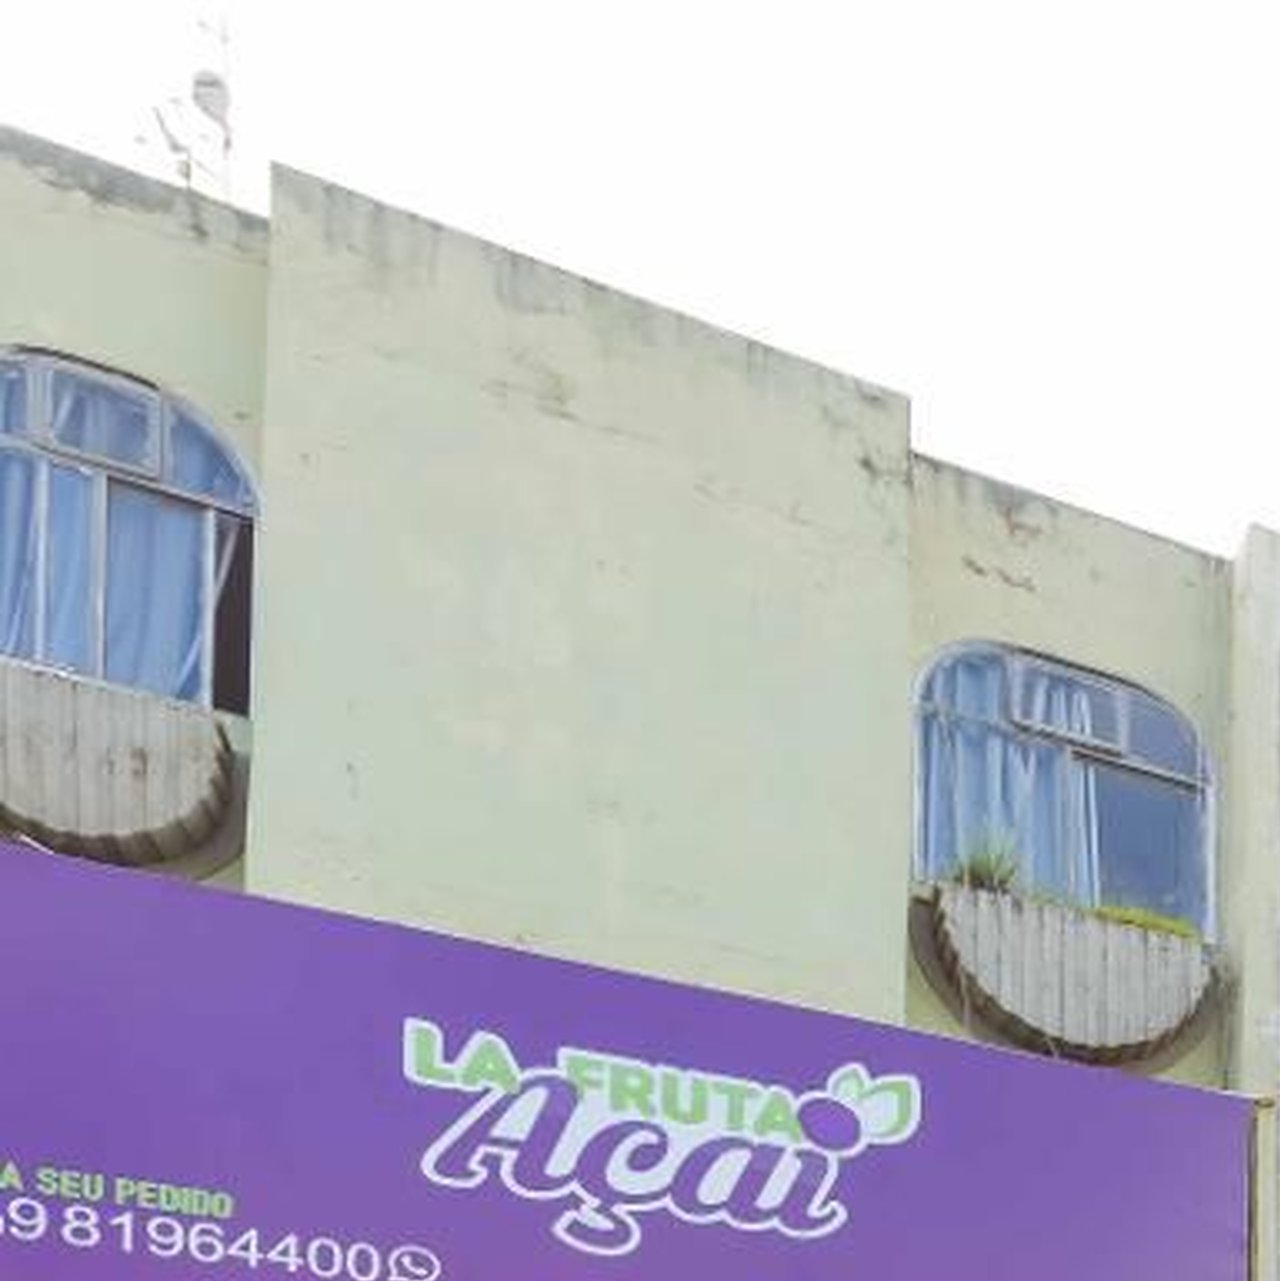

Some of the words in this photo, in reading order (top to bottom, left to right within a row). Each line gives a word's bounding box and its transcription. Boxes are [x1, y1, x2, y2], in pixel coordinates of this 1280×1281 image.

[404, 1018, 519, 1092] LA
[556, 1046, 803, 1144] FRUTA
[0, 1197, 48, 1240] 9
[36, 1167, 104, 1202] SEU
[115, 1177, 235, 1219] PEDIDO
